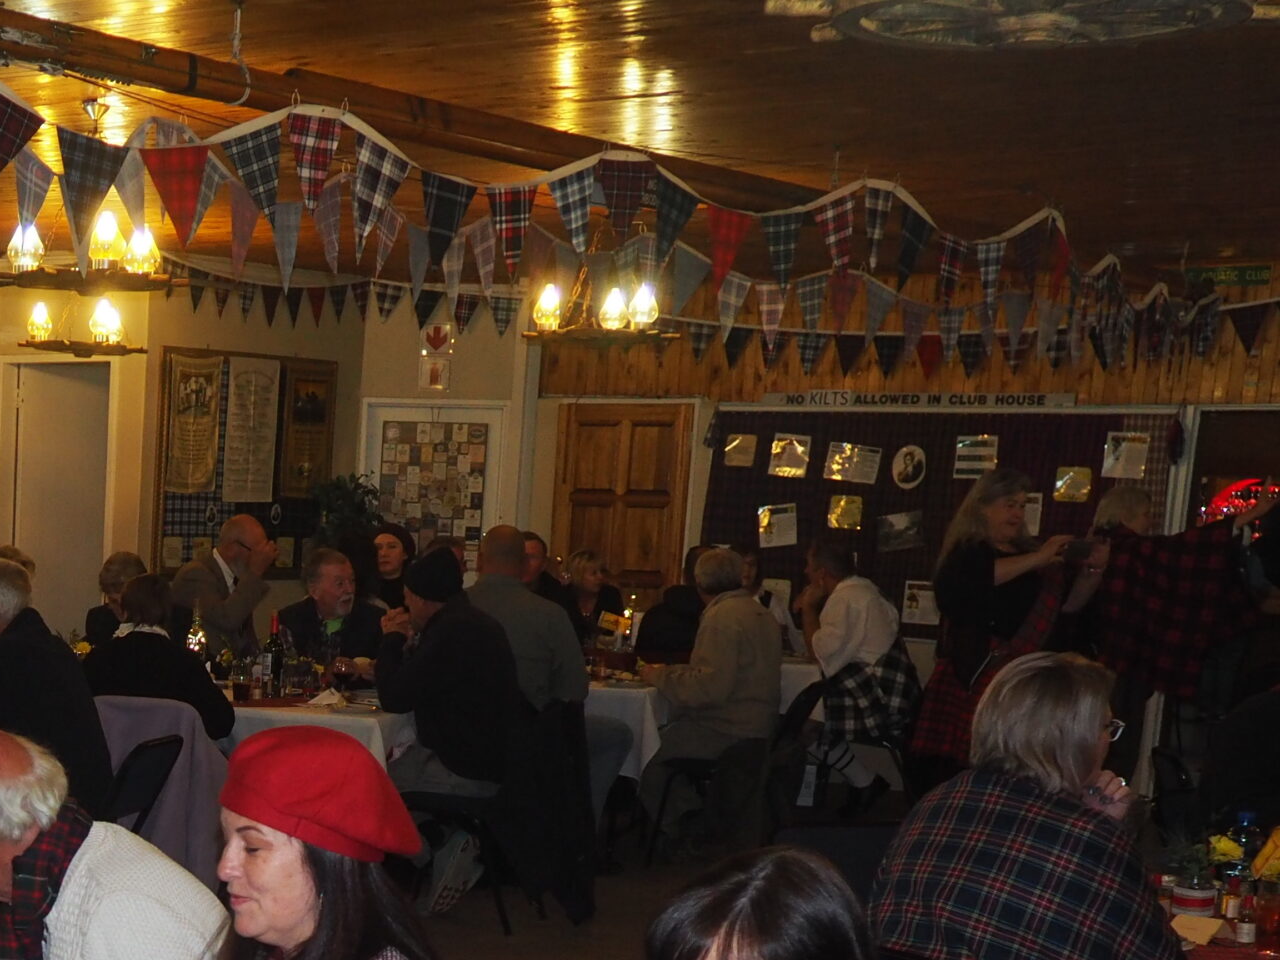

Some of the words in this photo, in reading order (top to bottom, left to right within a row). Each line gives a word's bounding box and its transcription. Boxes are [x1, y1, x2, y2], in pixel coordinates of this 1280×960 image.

[1245, 270, 1270, 281] CLUB
[785, 394, 805, 405] NO
[808, 391, 849, 406] KILTS
[853, 394, 921, 405] ALLOWED
[926, 394, 941, 405] IN
[948, 394, 988, 406] CLUB
[994, 394, 1047, 406] HOUSE
